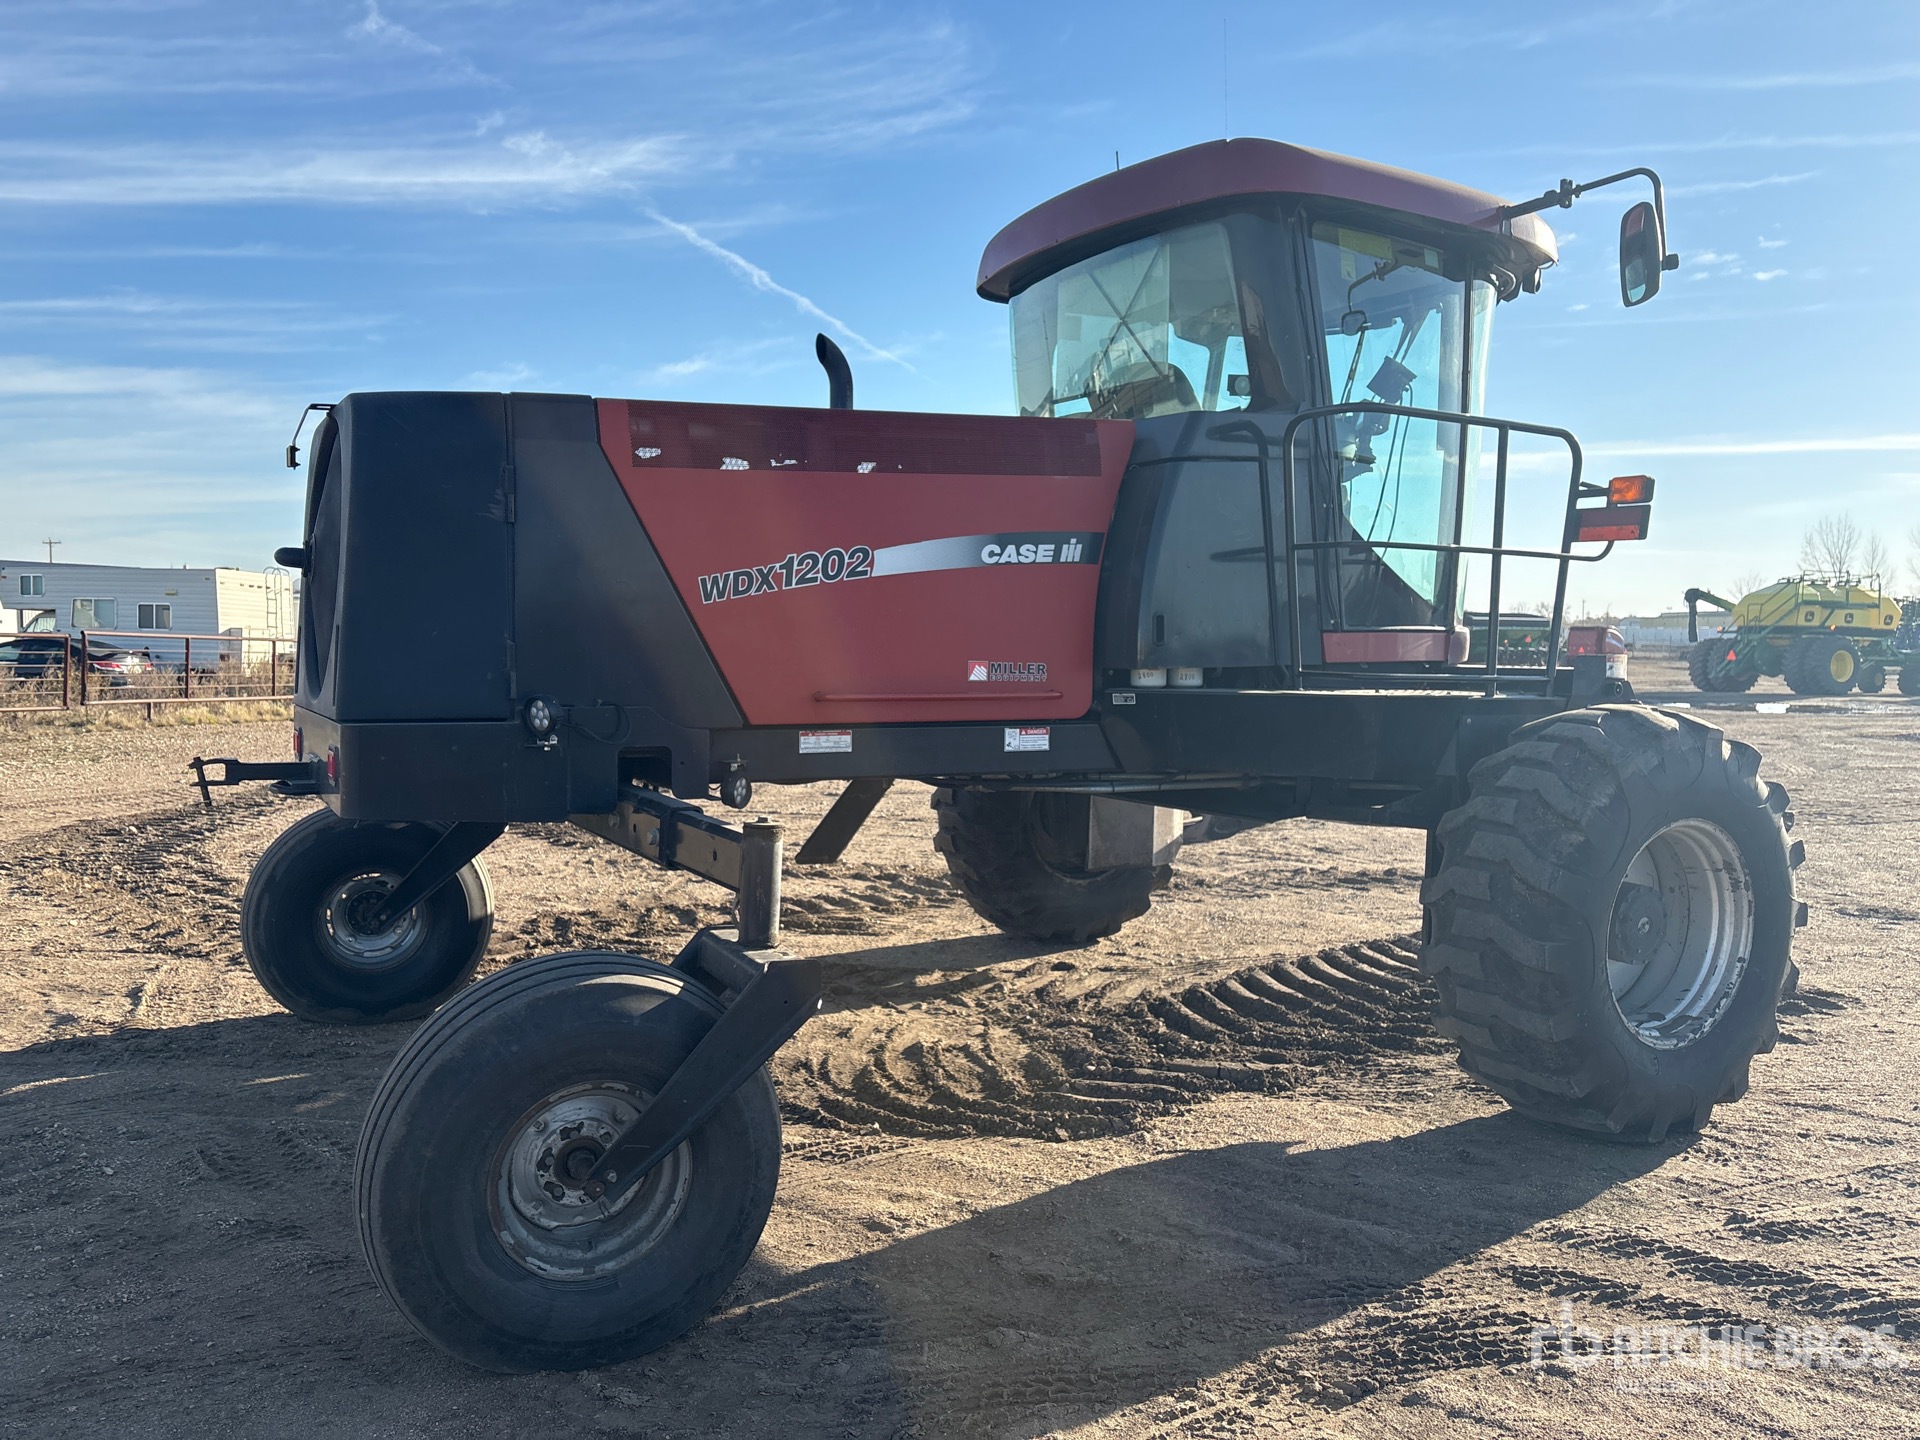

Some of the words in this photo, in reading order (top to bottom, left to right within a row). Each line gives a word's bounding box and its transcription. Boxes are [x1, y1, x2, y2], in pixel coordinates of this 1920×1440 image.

[981, 544, 1055, 564] CASE
[698, 545, 872, 604] WDX1202
[990, 662, 1047, 675] MILLER
[990, 674, 1048, 682] EQUIPMENT
